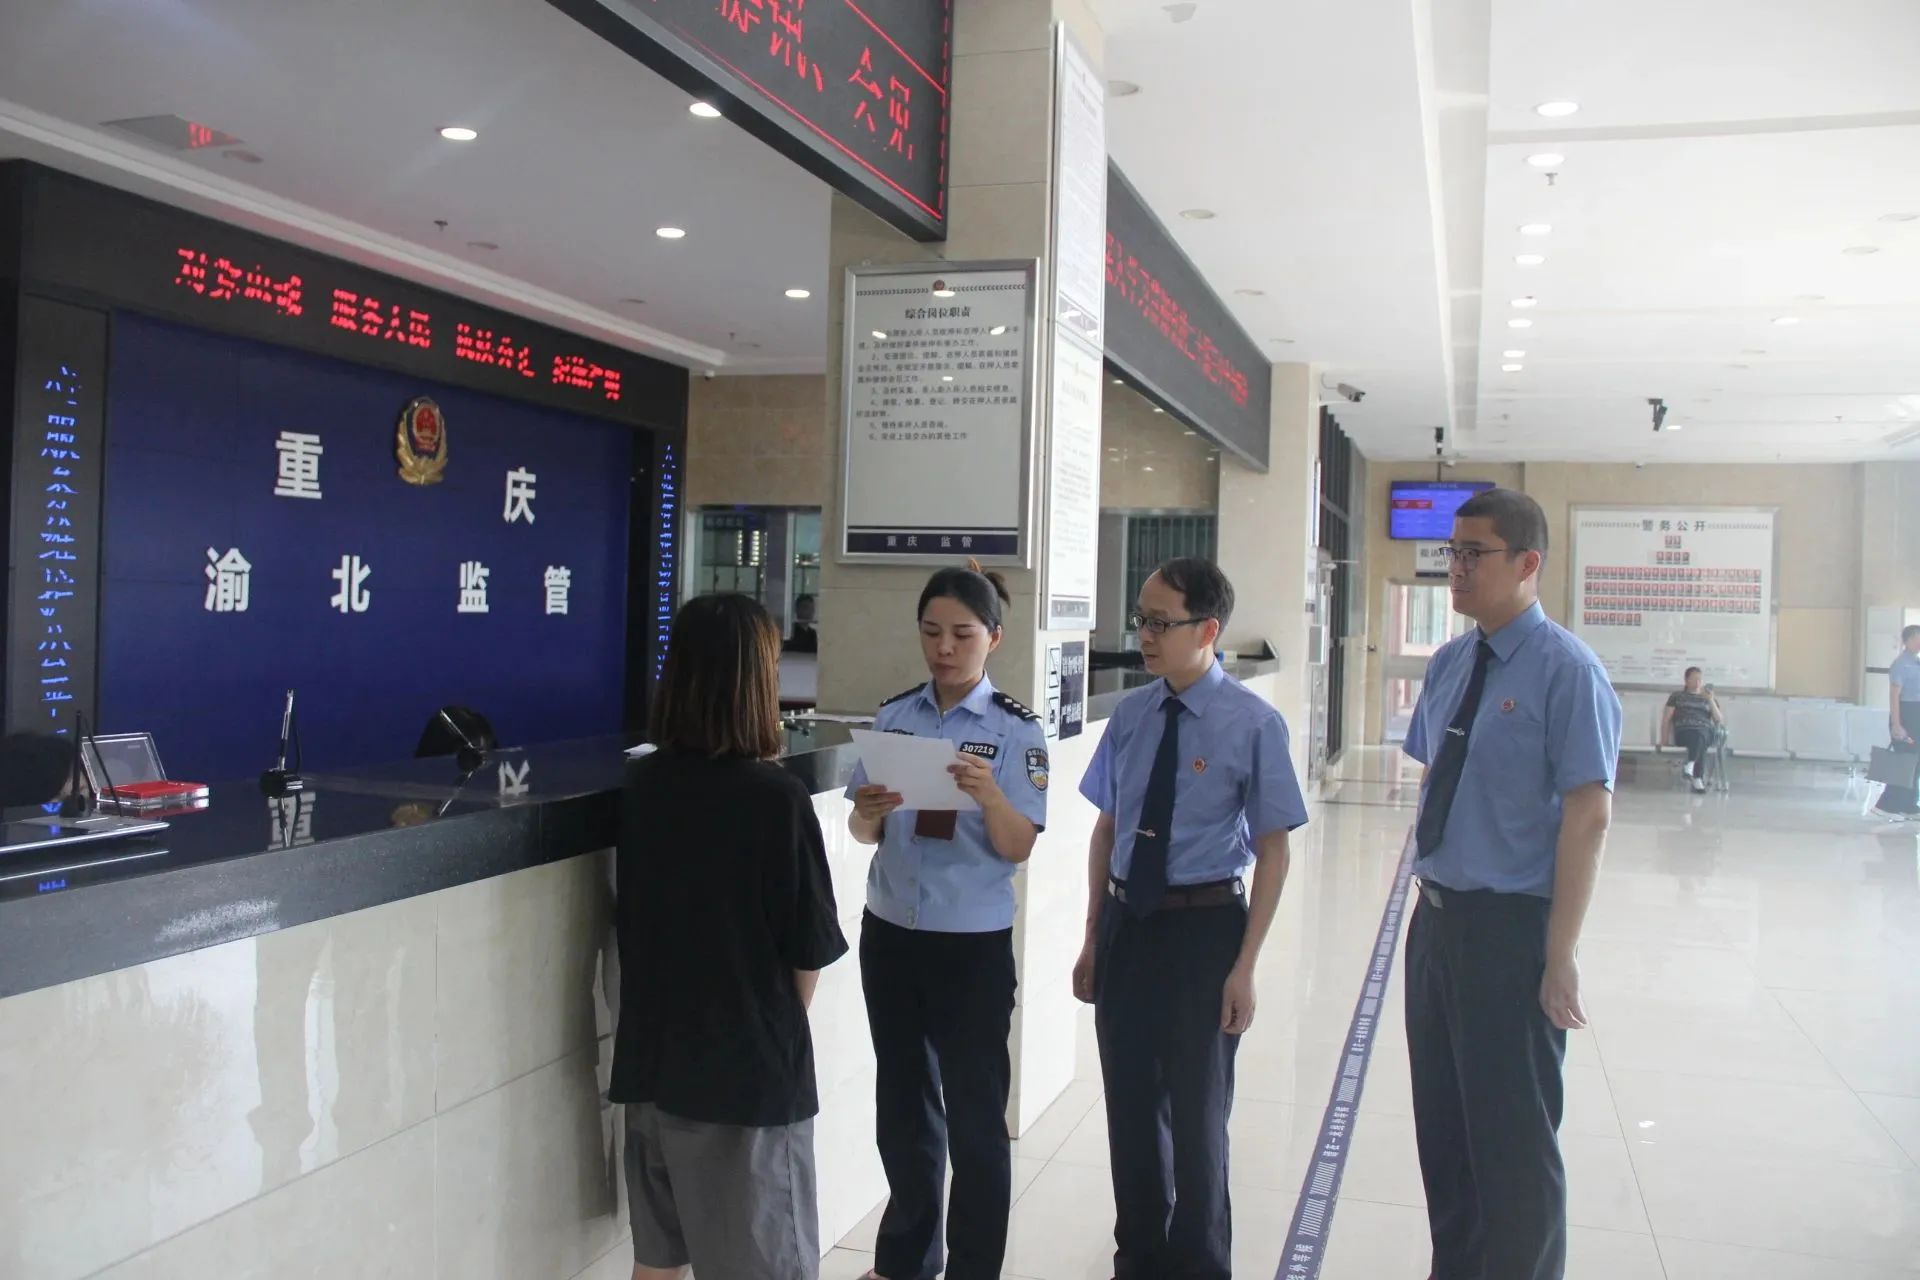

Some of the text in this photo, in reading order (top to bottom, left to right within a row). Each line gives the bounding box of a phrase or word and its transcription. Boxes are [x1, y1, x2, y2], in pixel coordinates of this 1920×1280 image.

[904, 306, 972, 320] 综合岗位职责
[1642, 519, 1707, 532] 警务公开
[962, 743, 995, 755] 307219
